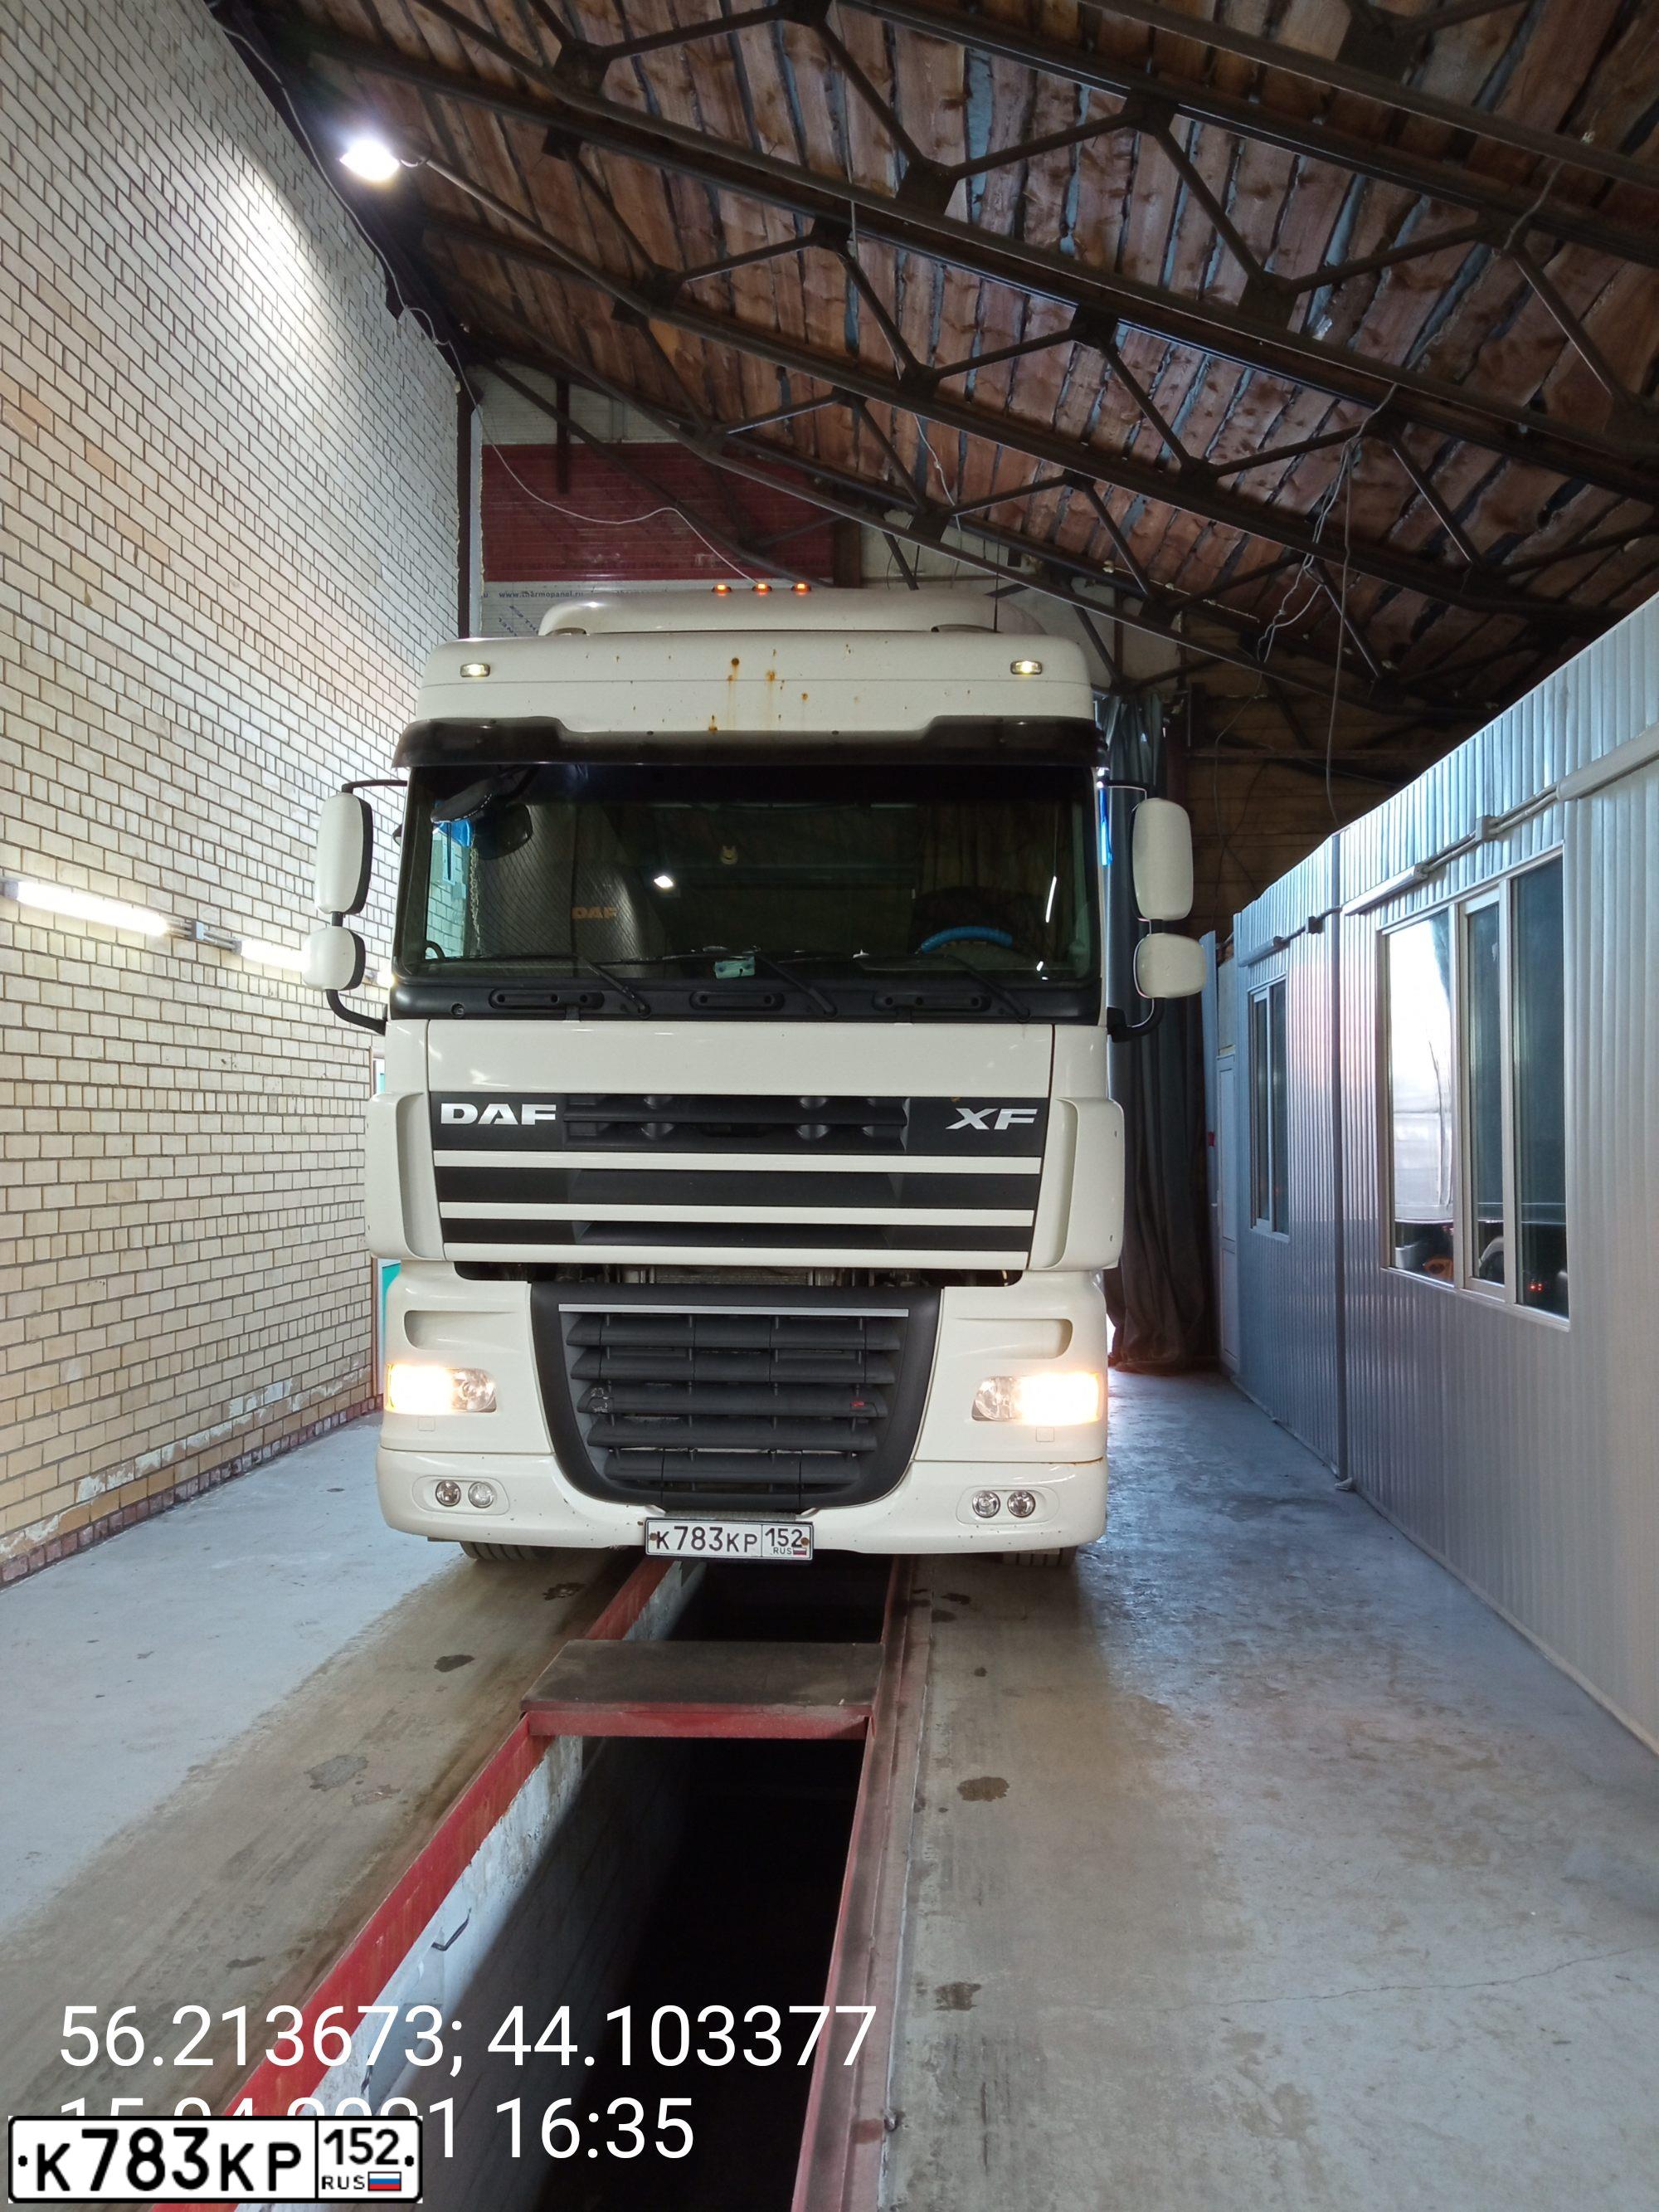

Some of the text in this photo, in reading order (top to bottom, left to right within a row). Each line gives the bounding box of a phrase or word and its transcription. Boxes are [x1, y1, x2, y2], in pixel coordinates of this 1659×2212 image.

[440, 1103, 557, 1125] DAF
[946, 1108, 1038, 1130] XF
[765, 1527, 803, 1547] 152
[773, 1547, 792, 1555] RUS
